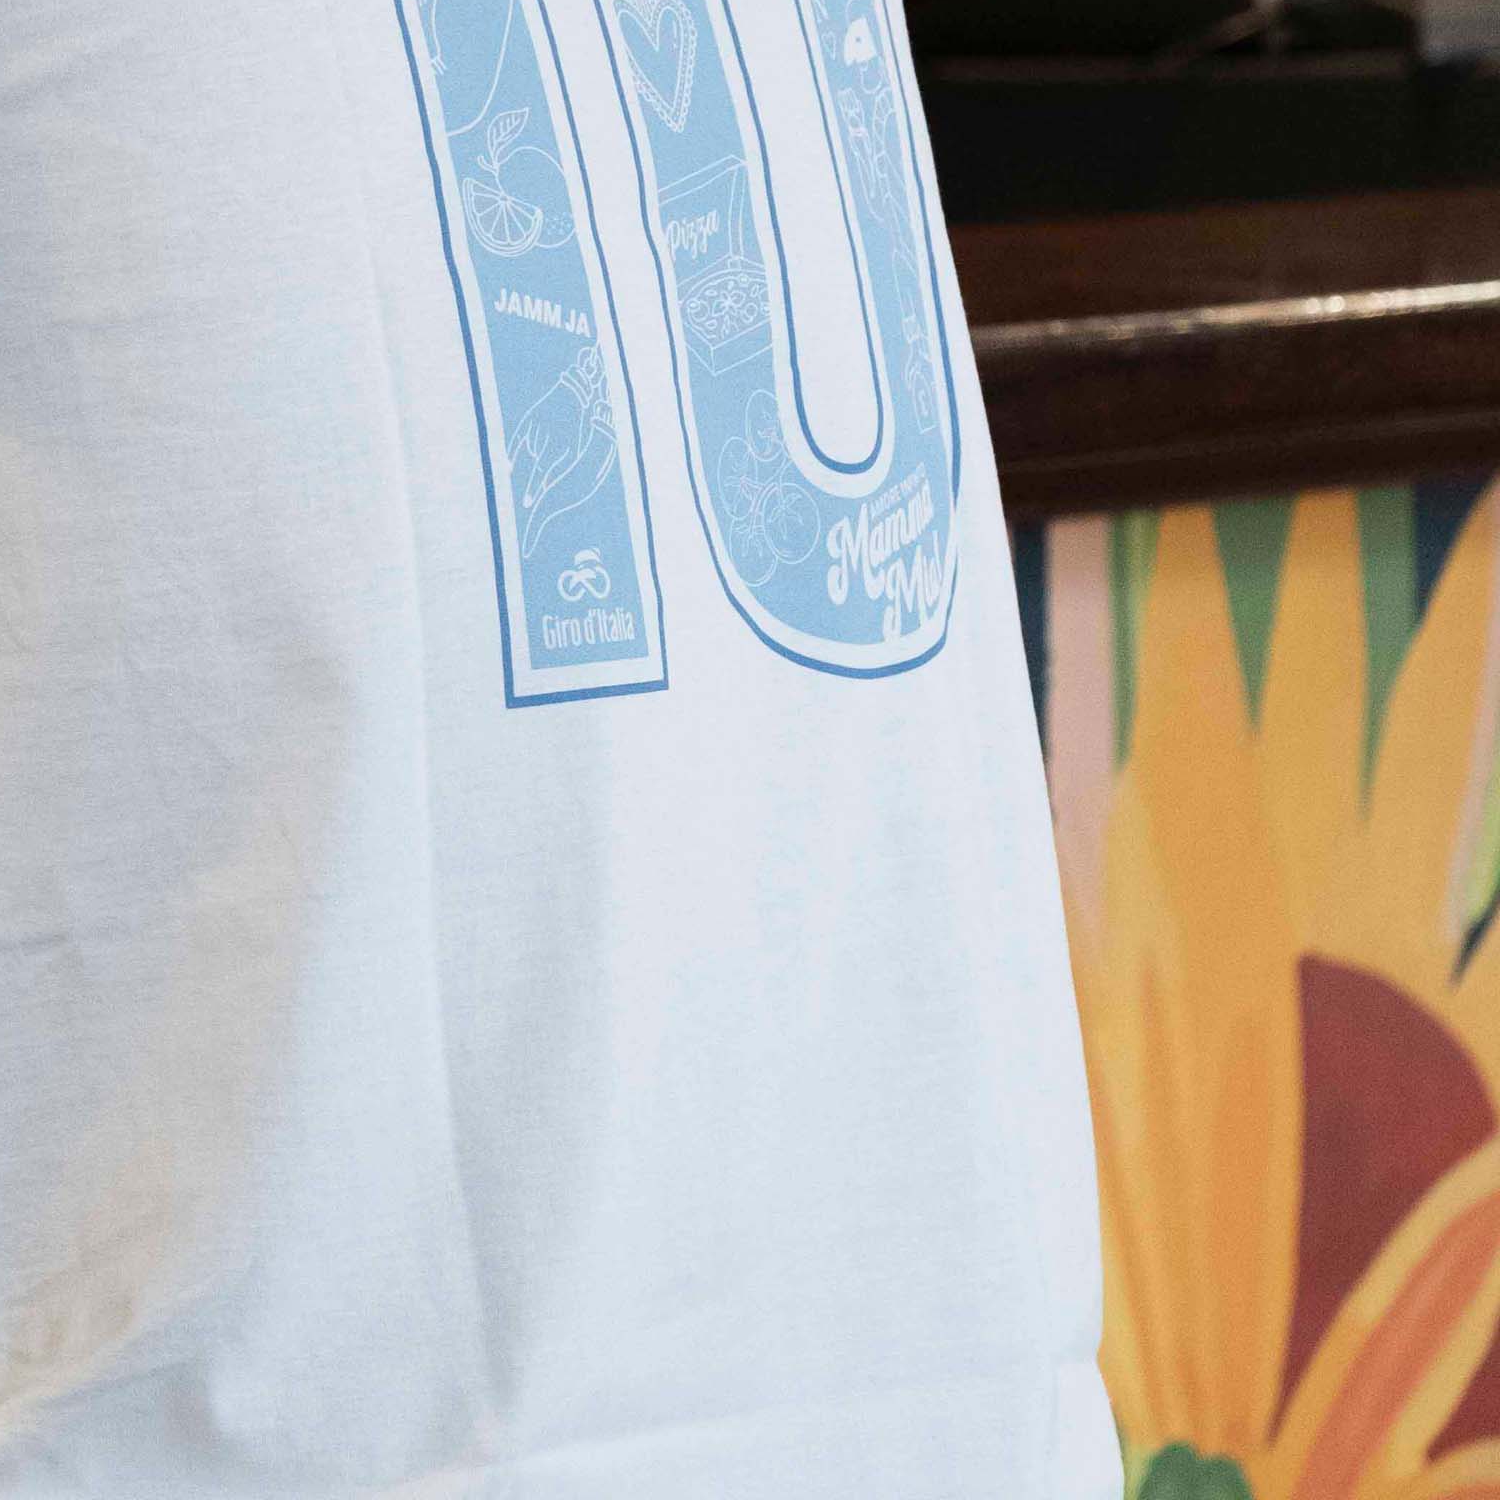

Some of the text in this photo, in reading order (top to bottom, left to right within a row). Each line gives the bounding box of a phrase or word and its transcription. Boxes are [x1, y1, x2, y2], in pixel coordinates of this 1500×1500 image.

[494, 287, 591, 338] JAMM JA
[542, 614, 581, 650] Giro
